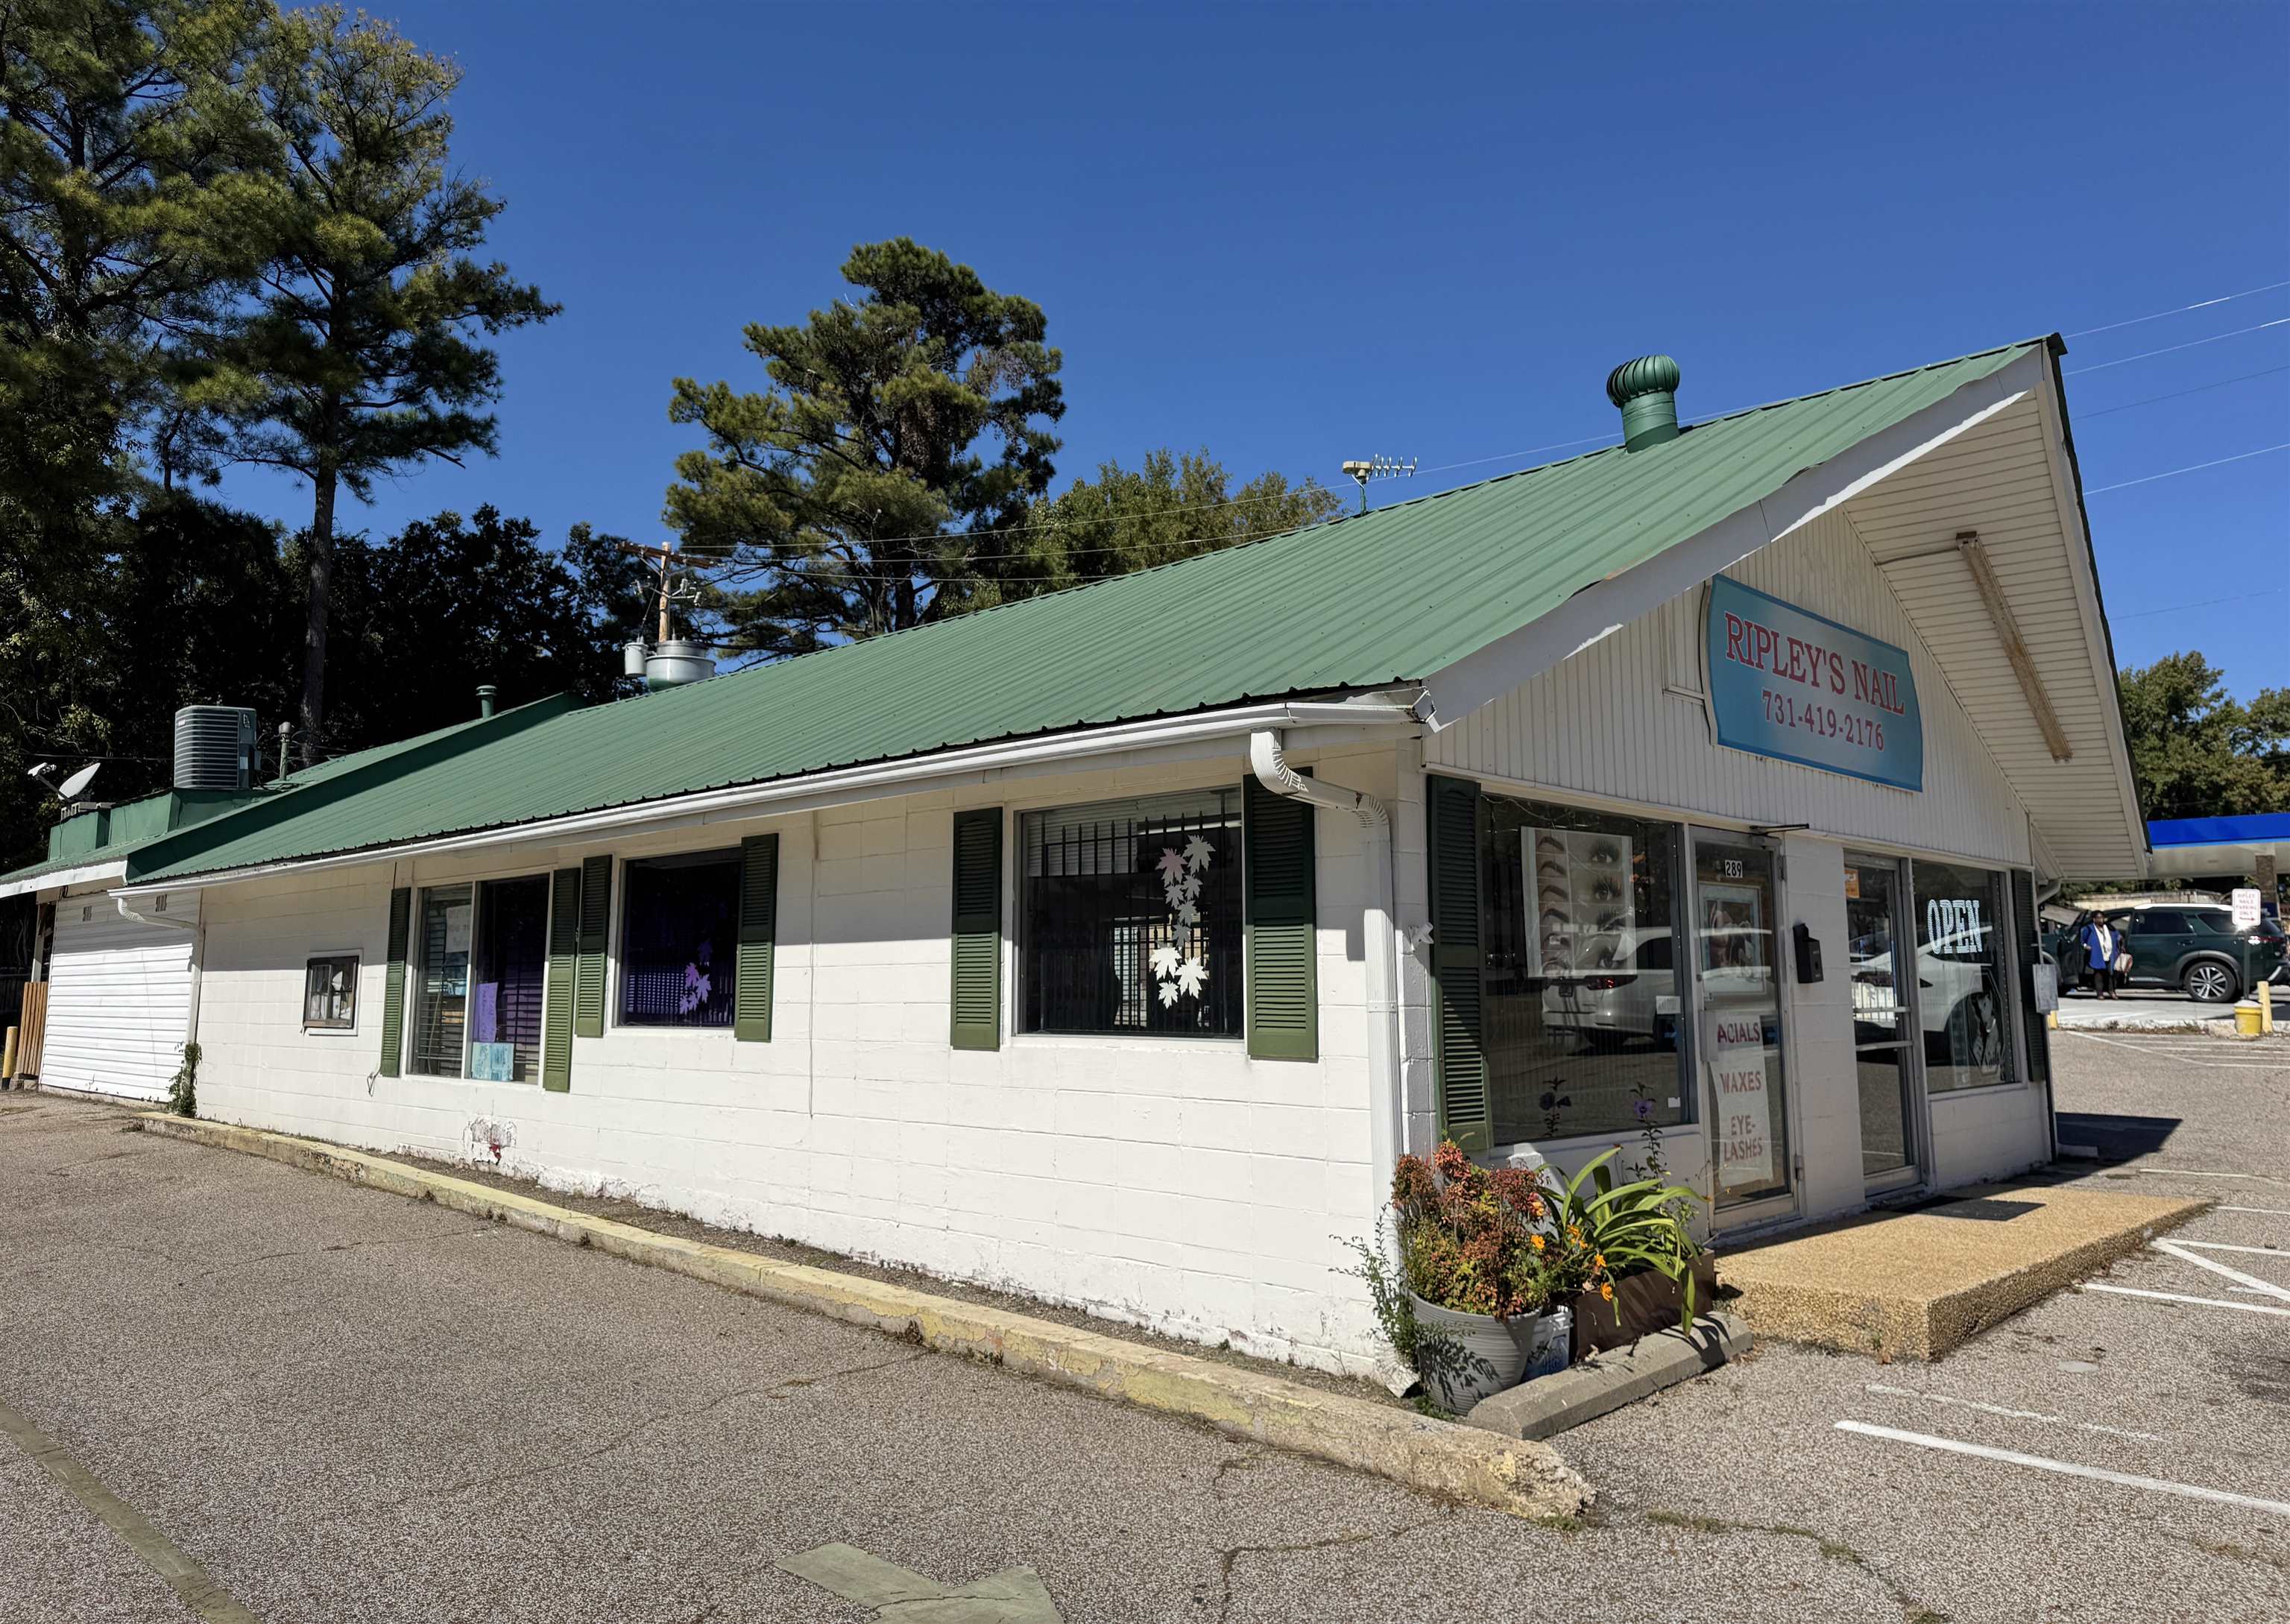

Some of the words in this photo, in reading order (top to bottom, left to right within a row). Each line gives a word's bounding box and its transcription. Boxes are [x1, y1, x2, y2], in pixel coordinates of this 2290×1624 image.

[1724, 611, 1846, 695] RIPLEY'S
[1851, 659, 1905, 715] NAIL
[1762, 689, 1884, 751] 731-419-2176
[1726, 861, 1741, 877] 289
[1927, 899, 1983, 954] OPEN
[1717, 1022, 1761, 1043] ACIALS
[1720, 1071, 1761, 1095] WAXES
[1723, 1138, 1764, 1162] LASHES
